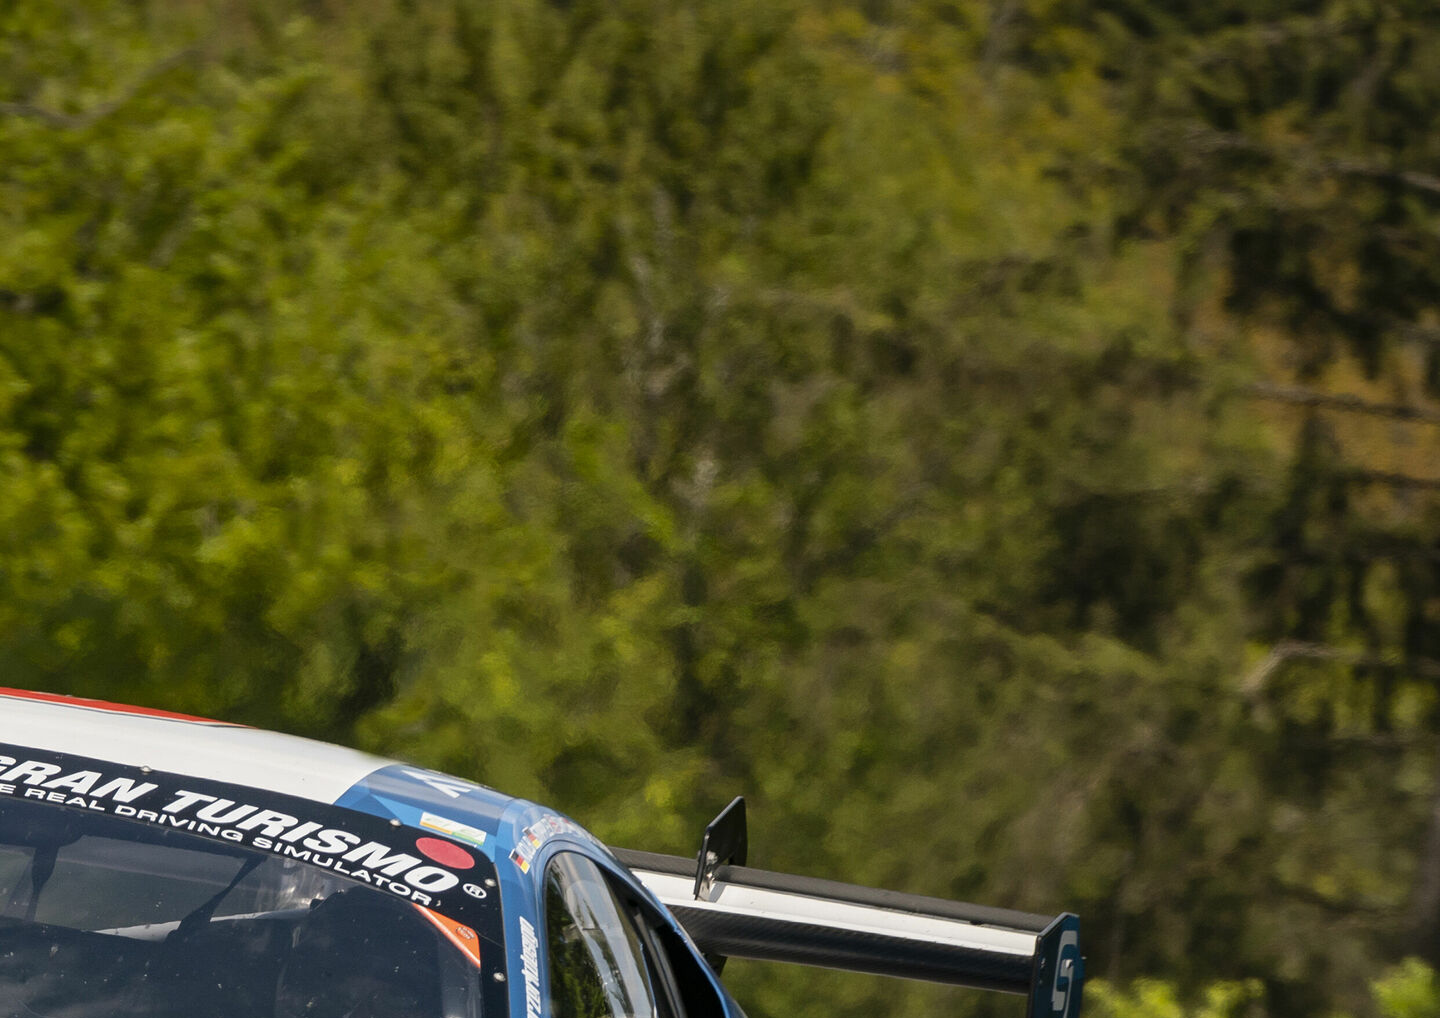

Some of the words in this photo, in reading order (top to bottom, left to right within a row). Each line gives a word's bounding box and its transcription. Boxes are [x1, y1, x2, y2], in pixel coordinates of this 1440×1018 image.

[23, 787, 106, 812] REAL
[114, 803, 245, 843] DRIVING
[251, 837, 433, 907] SIMULATOR
[159, 790, 459, 893] TURISMO
